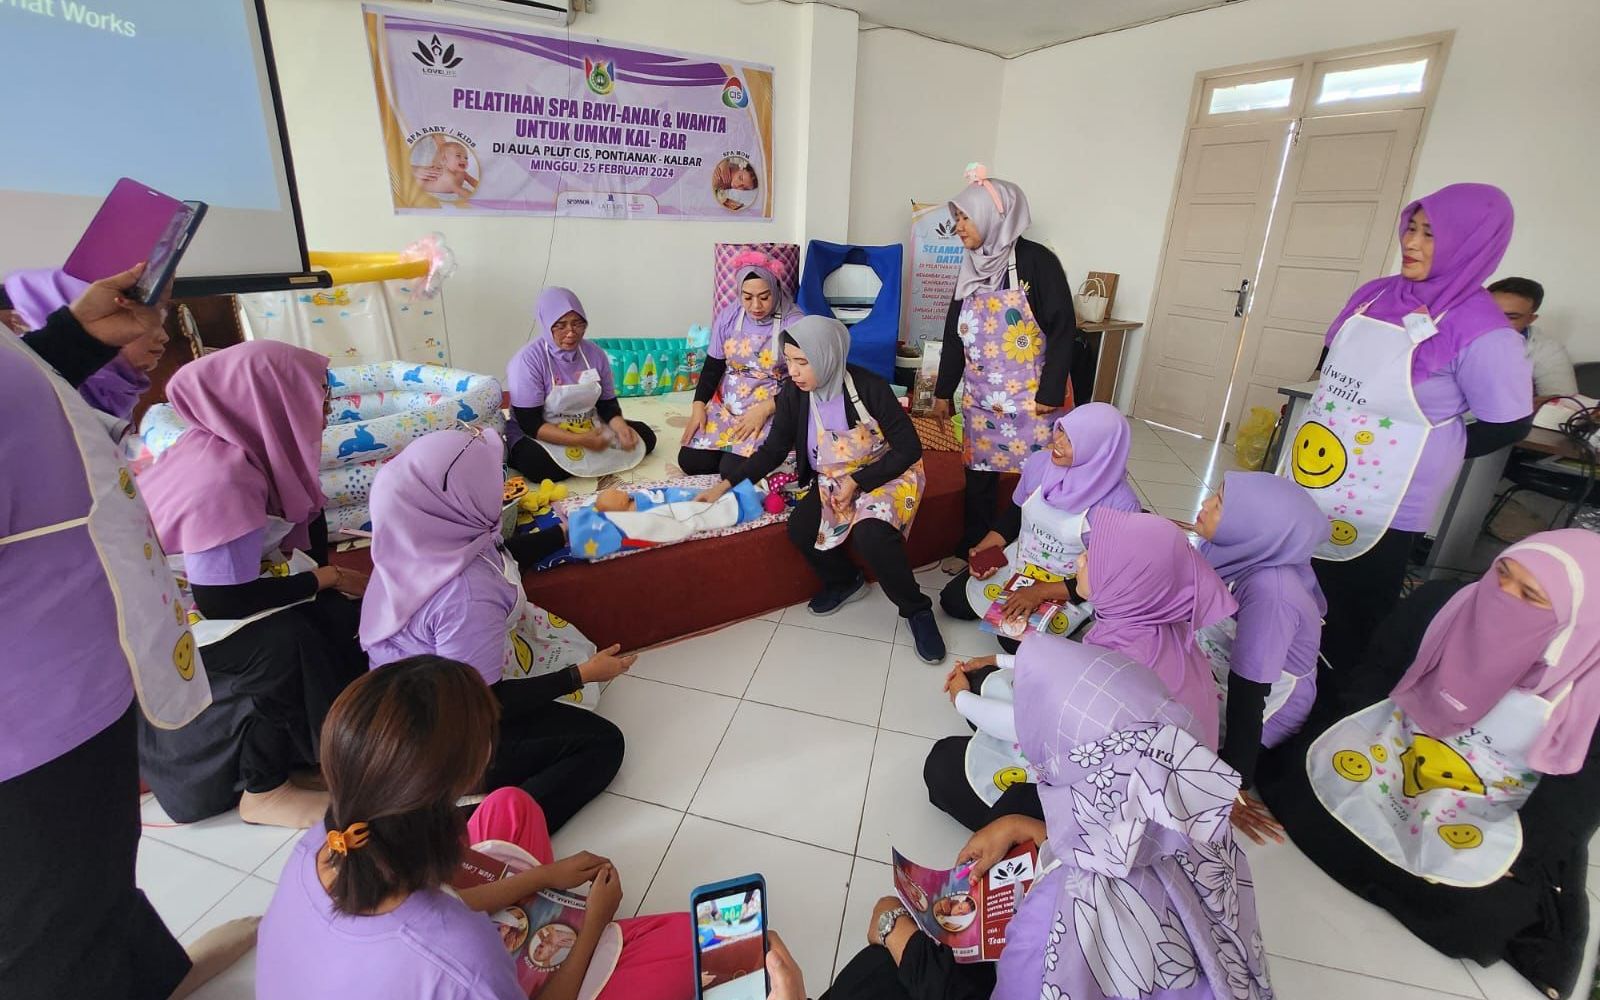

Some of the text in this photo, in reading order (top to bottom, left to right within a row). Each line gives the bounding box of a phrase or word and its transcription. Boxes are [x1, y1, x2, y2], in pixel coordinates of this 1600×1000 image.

[61, 0, 136, 37] Works
[729, 91, 742, 100] CIS
[453, 88, 726, 133] PELATIHAN SPA BAYI-ANAK & WANITA
[407, 131, 421, 144] SPA
[422, 126, 446, 134] BABY
[515, 119, 570, 141] UNTUK
[573, 123, 622, 145] UMKM
[660, 132, 687, 150] BAR
[492, 142, 505, 153] DI
[507, 144, 541, 156] AULA
[544, 146, 571, 157] PLUT
[574, 148, 592, 161] CIS,
[595, 149, 656, 164] PONTIANAK
[663, 155, 702, 167] KALBAR
[530, 160, 674, 178] MINGGU, 25 FEBRUARI 2024
[922, 244, 964, 254] SELAMAT
[1327, 385, 1366, 405] smile
